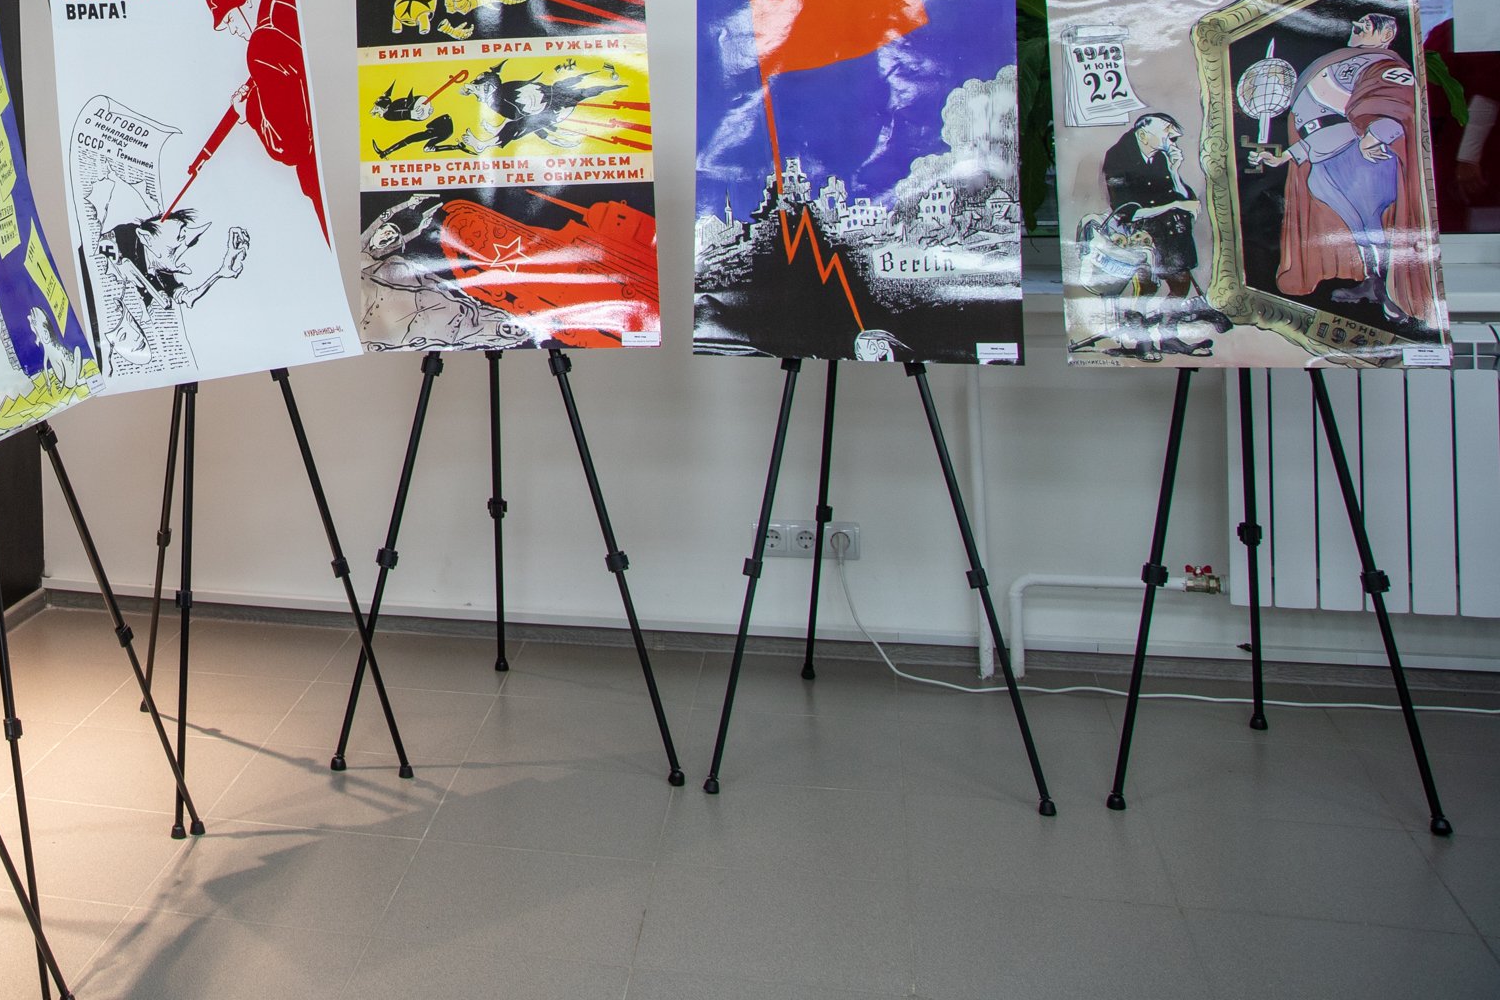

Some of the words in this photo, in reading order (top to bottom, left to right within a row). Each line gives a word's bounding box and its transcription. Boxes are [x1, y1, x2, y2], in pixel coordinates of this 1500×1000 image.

[65, 0, 127, 20] ВРАГА!
[378, 47, 422, 60] БИЛИ
[437, 45, 465, 56] МЫ
[481, 42, 533, 54] ВРАГА
[545, 38, 628, 51] РУЖЬЕМ,
[1083, 70, 1128, 103] 22
[94, 108, 150, 137] ДОГОВОР
[77, 132, 104, 150] СССР
[95, 121, 149, 149] ненападении
[101, 133, 128, 148] между
[372, 165, 381, 174] И
[390, 163, 442, 174] ТЕПЕРЬ
[445, 159, 529, 171] СТАЛЬНЫМ
[545, 155, 631, 169] ОРУЖЬЕМ
[380, 177, 422, 187] БЬЕМ
[437, 175, 494, 186] ВРАГА,
[506, 172, 535, 183] ГДЕ
[543, 167, 645, 182] ОБНАРУЖИМ!
[879, 254, 957, 273] Berlin
[1331, 317, 1376, 337] ИЮНЬ
